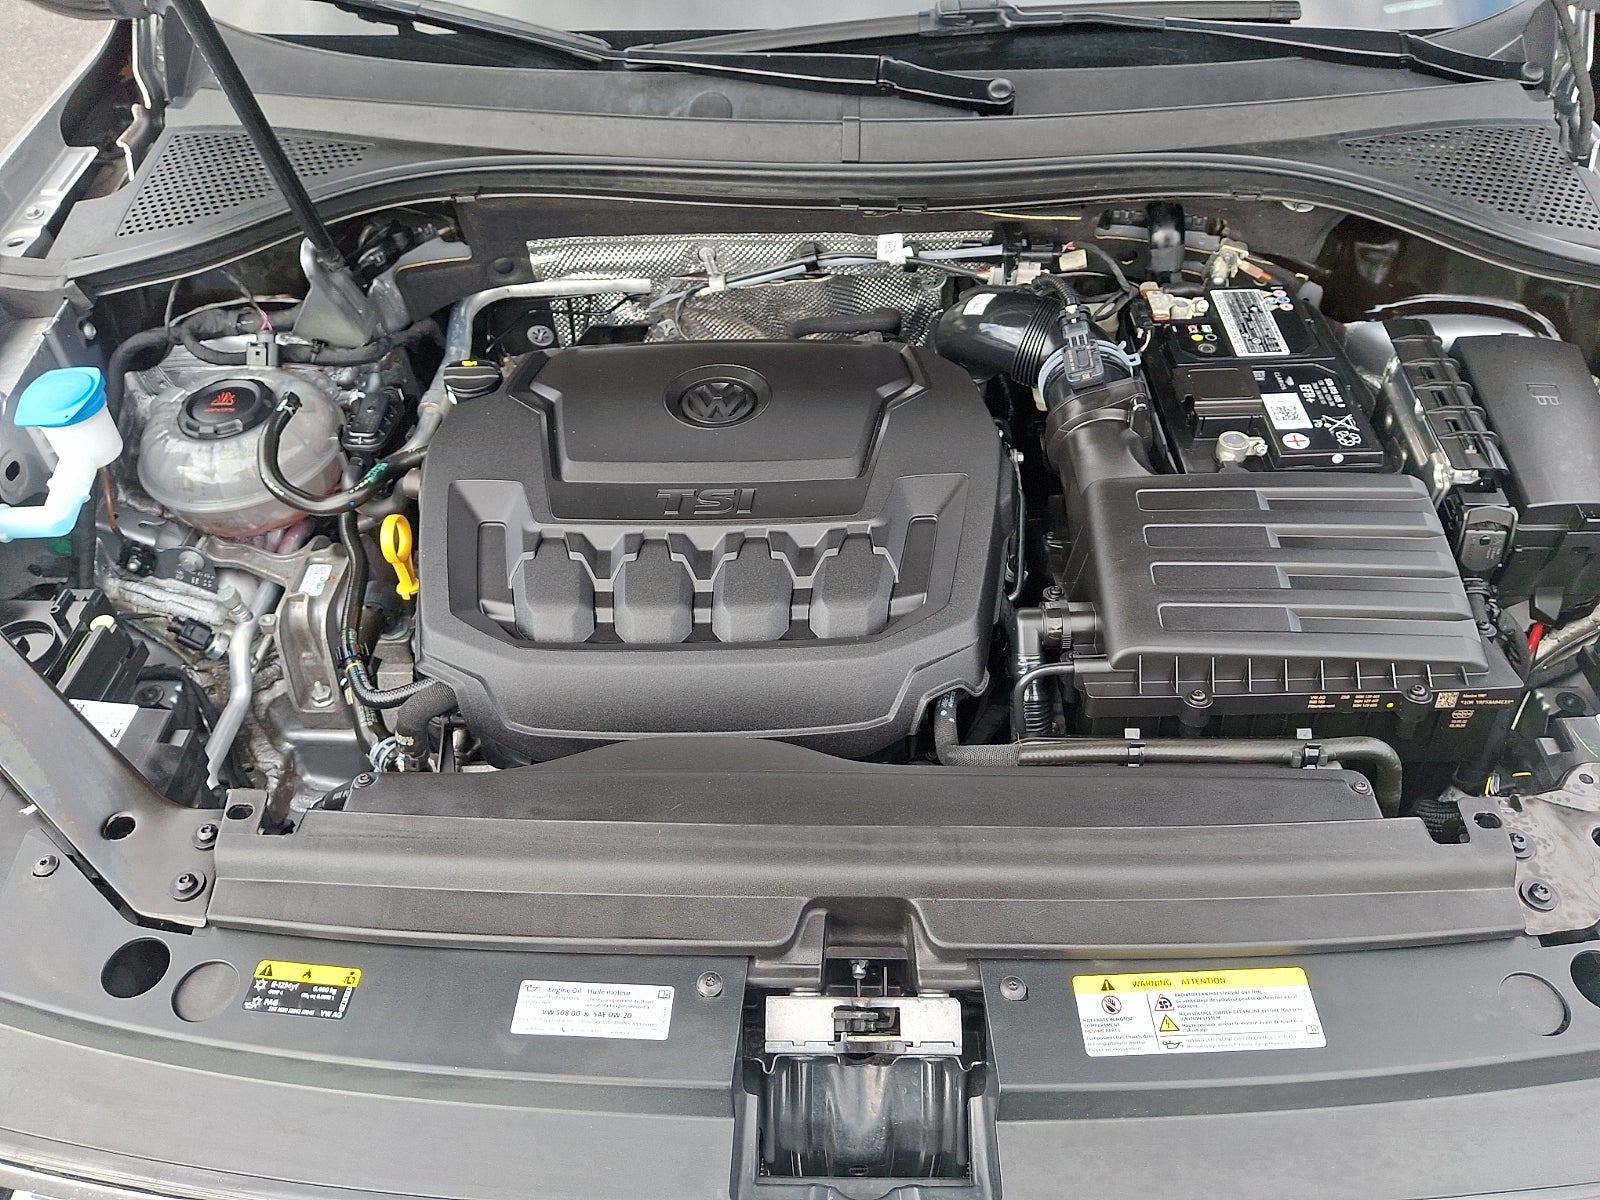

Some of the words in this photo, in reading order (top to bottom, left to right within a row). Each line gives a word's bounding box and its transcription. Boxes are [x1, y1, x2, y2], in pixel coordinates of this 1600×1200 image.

[1298, 384, 1316, 403] EFB+
[656, 488, 758, 514] TSI
[110, 728, 121, 737] R
